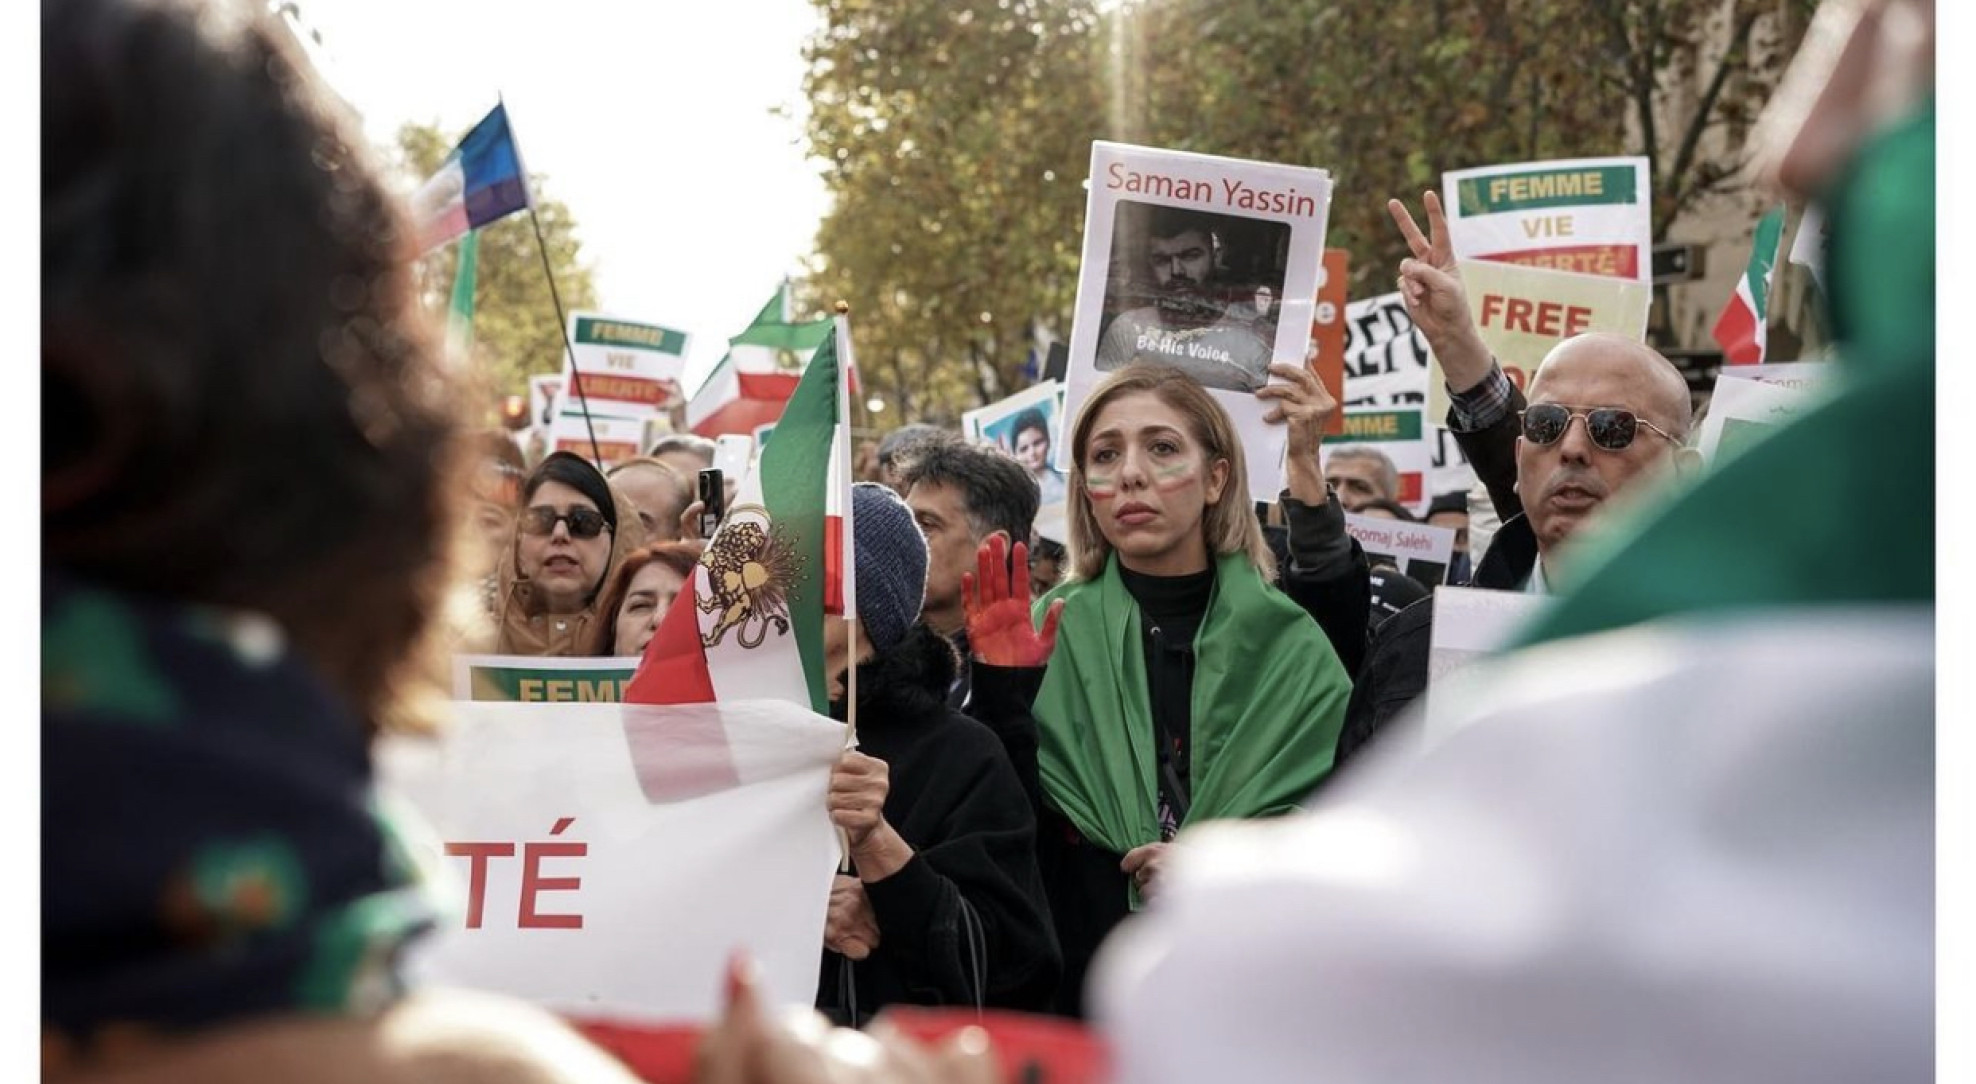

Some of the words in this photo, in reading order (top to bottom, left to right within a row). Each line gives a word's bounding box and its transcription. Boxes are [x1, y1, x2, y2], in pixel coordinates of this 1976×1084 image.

[1107, 163, 1212, 203] Saman
[1222, 178, 1315, 217] Yassin
[1490, 171, 1604, 203] FEMME
[1521, 215, 1574, 238] VIE
[1481, 293, 1593, 338] FREE
[591, 321, 664, 347] FEMME
[606, 353, 635, 369] VIE
[1137, 335, 1156, 351] Be
[1160, 338, 1184, 356] His
[1188, 342, 1230, 361] Voice
[1346, 523, 1393, 549] Toomaj
[1396, 530, 1433, 552] Salehi
